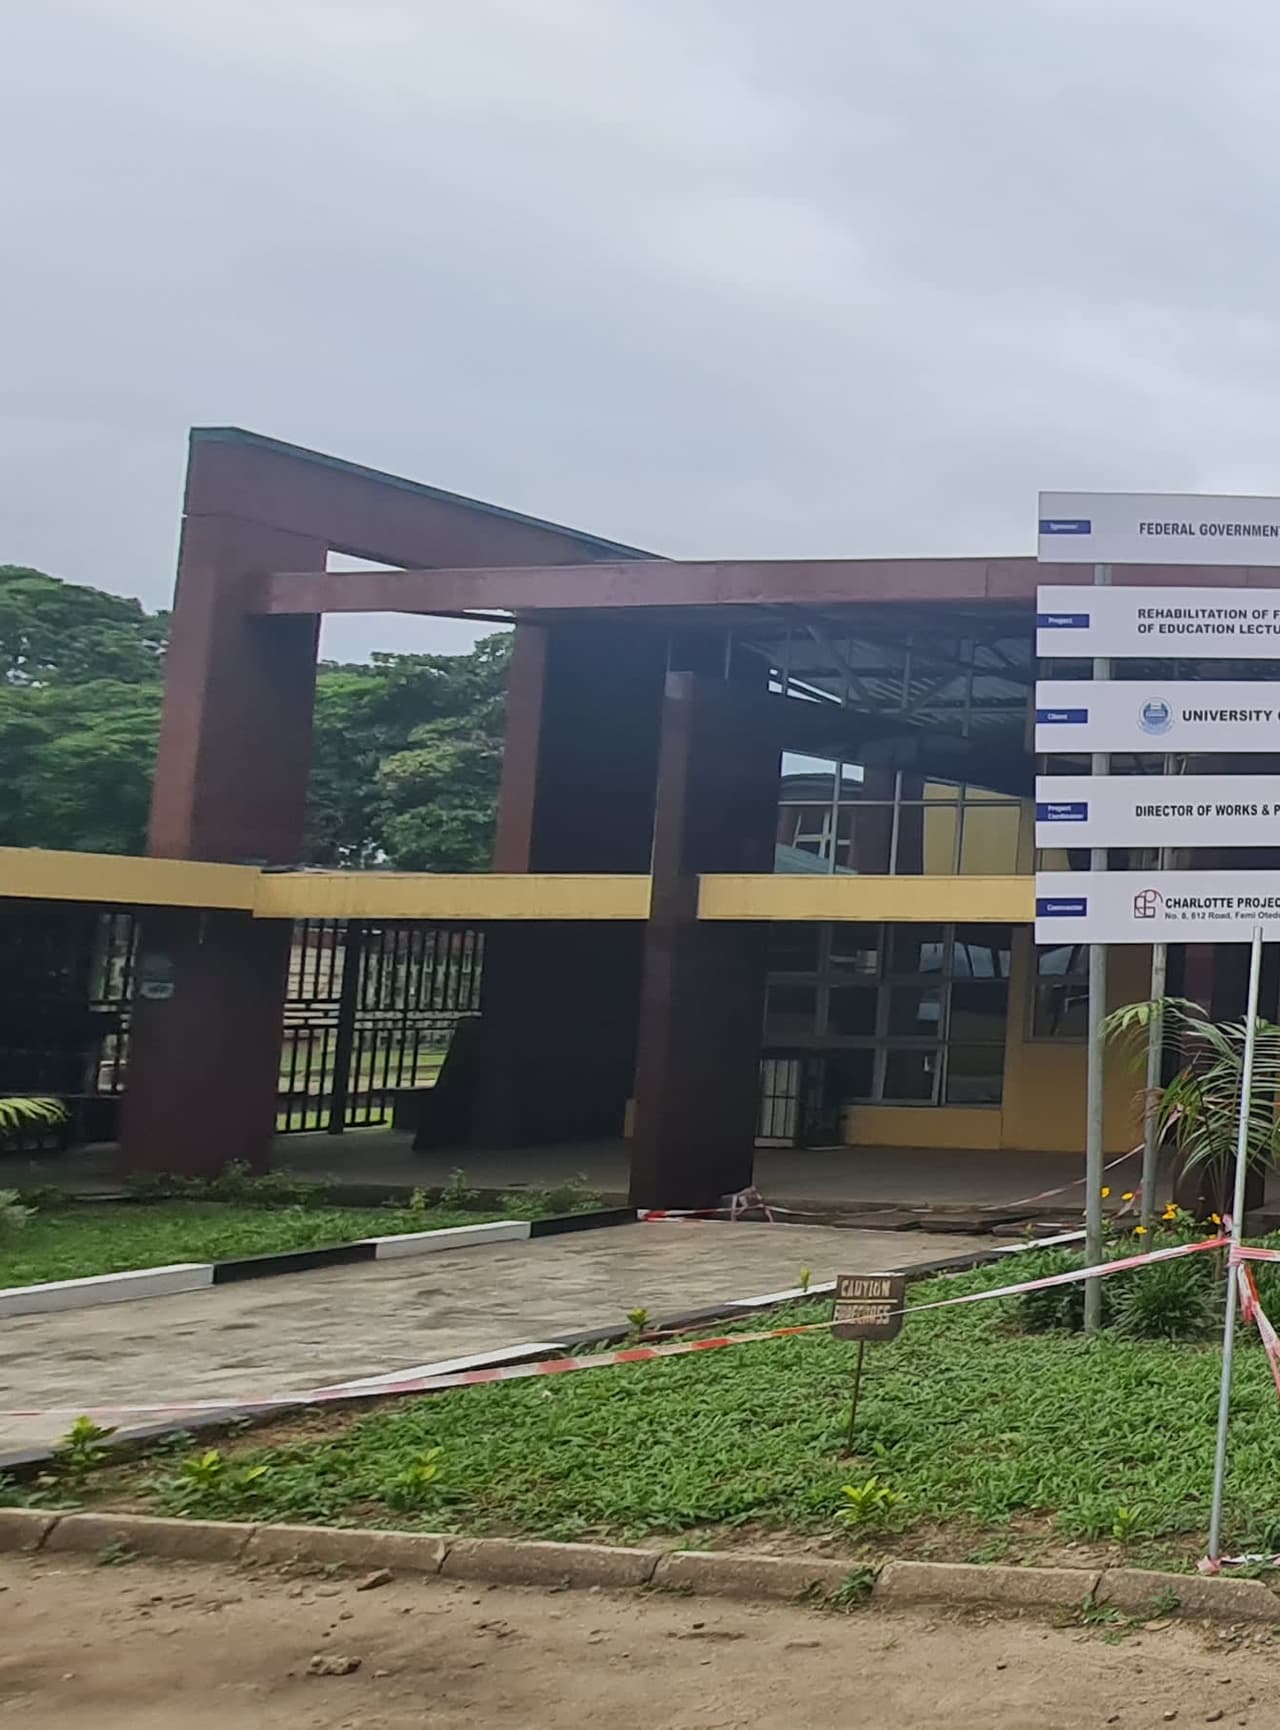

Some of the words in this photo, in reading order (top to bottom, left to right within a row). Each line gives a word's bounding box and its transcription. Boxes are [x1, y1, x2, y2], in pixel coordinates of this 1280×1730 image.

[1139, 522, 1196, 536] FEDERAL
[1137, 608, 1248, 620] REHABILITATION
[1251, 609, 1269, 620] OF
[1137, 623, 1155, 634] OF
[1158, 623, 1235, 634] EDUCATION
[1182, 709, 1273, 722] UNIVERSITY
[1135, 804, 1194, 817] DIRECTOR
[1196, 804, 1213, 817] OF
[1215, 804, 1258, 817] WORKS
[1261, 804, 1270, 816] &
[1165, 897, 1234, 909] CHARLOTTE
